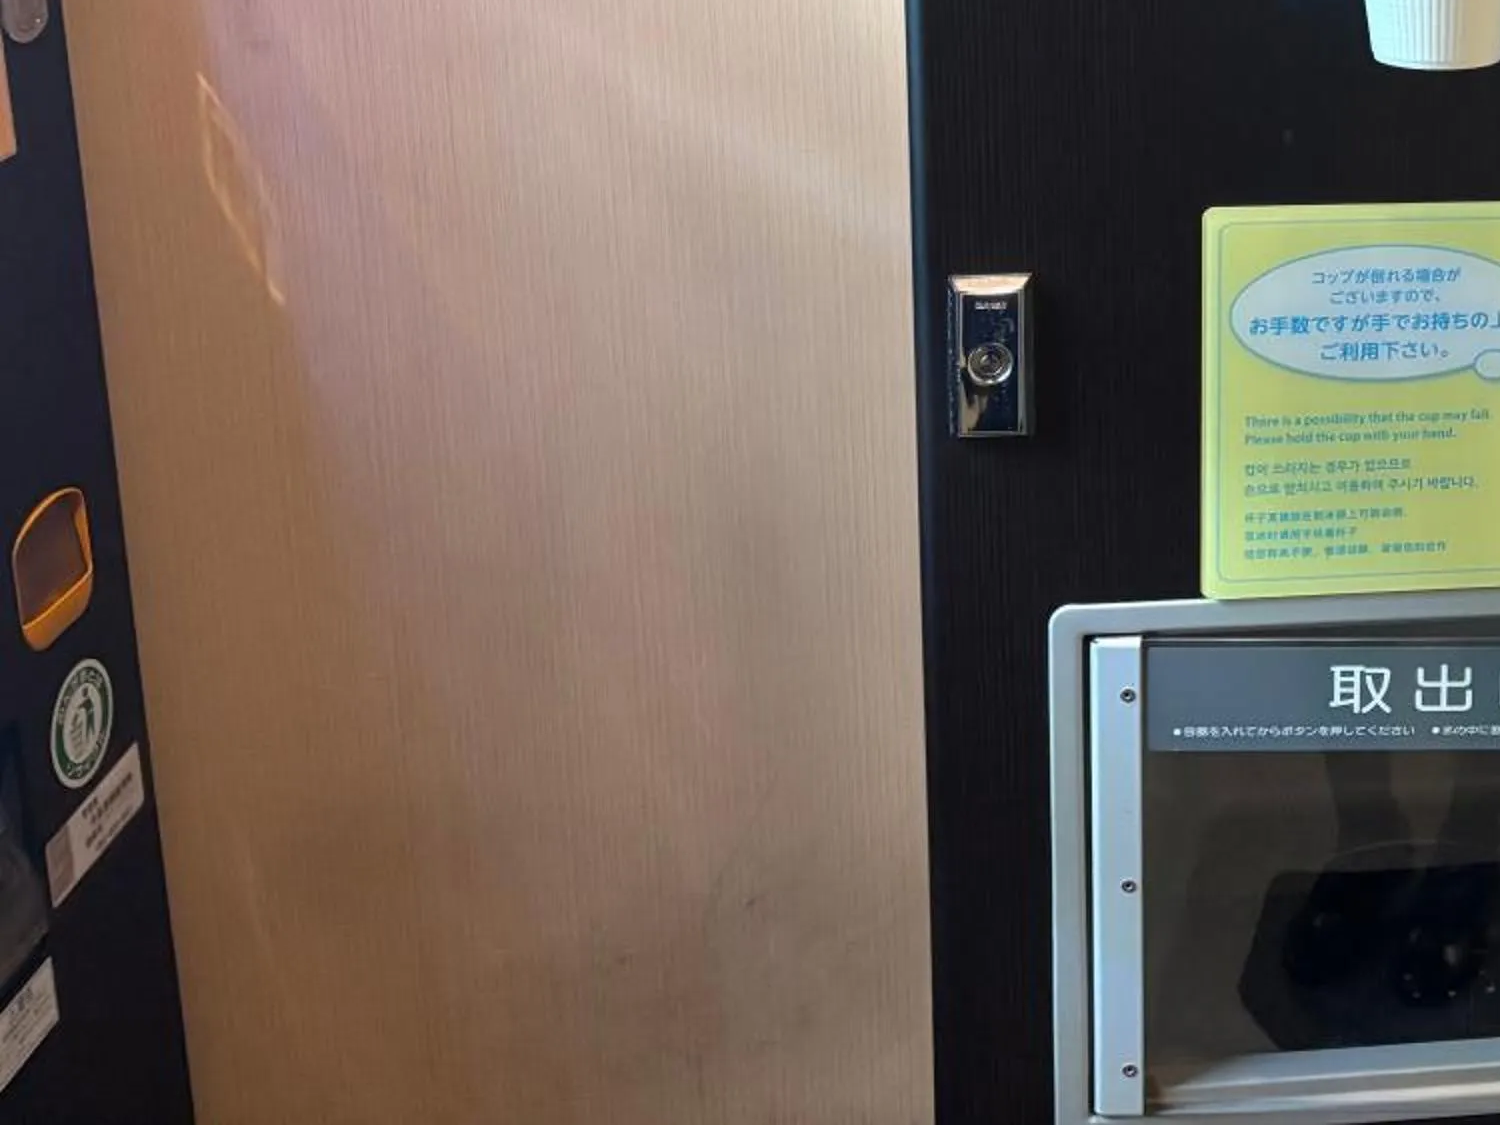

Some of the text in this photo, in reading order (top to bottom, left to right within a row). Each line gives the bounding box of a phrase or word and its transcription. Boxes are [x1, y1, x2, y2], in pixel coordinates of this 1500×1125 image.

[1311, 266, 1463, 285] コップが倒れる場合が
[1320, 342, 1450, 362] ご利用下さい。
[1245, 416, 1280, 428] There
[1285, 432, 1314, 444] hold
[1316, 432, 1336, 443] the
[1339, 432, 1361, 443] cup
